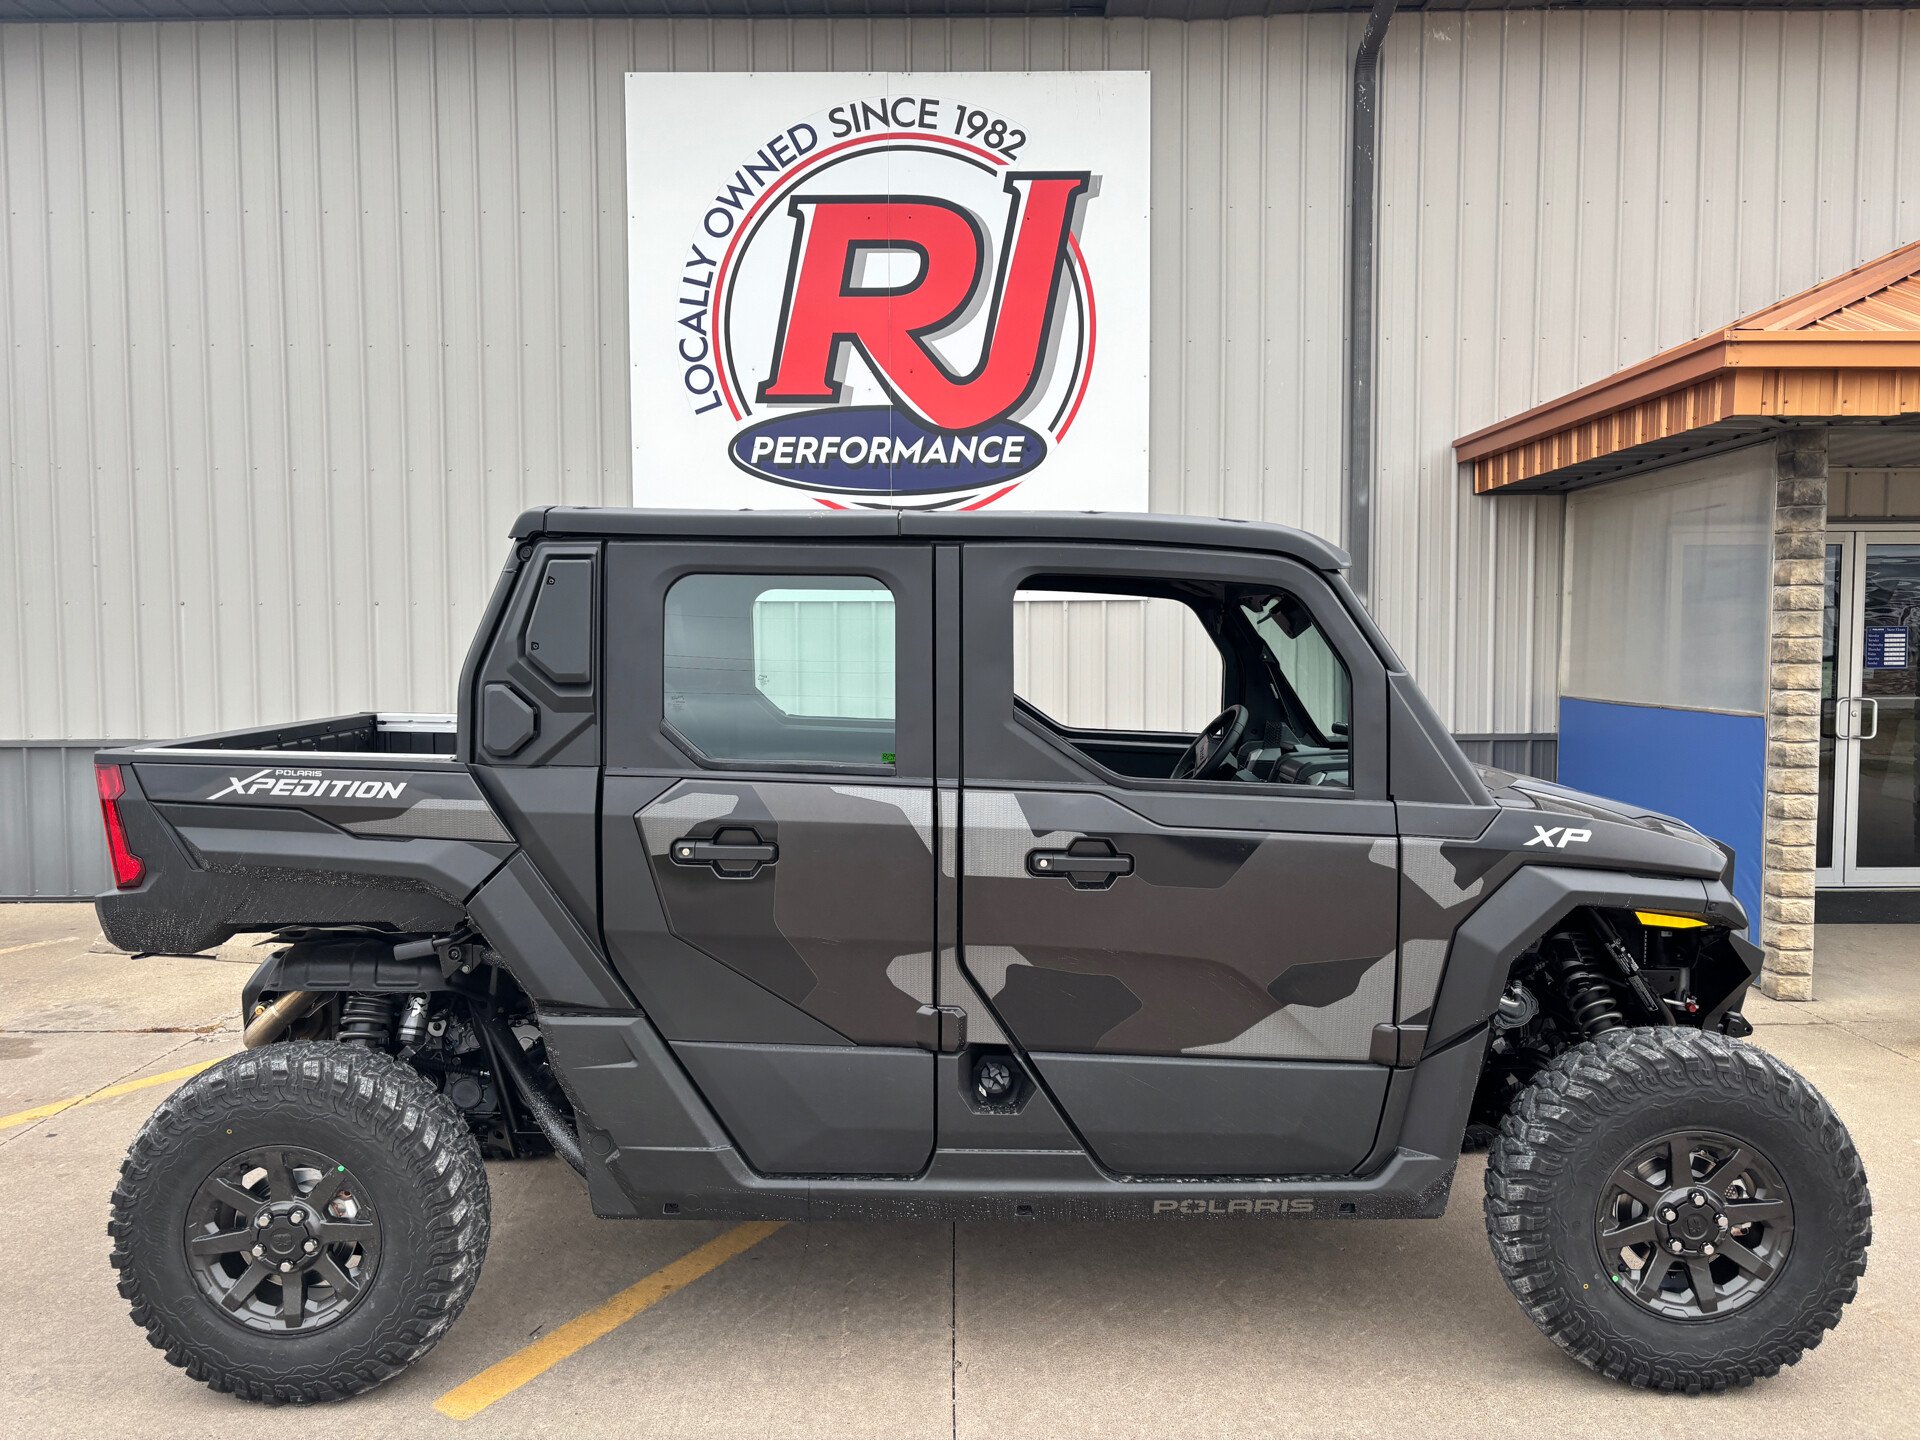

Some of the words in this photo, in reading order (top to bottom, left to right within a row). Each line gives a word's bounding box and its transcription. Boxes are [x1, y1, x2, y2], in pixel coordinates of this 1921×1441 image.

[677, 243, 723, 415] LOCALLY
[704, 123, 818, 238] OWNED
[828, 97, 940, 138] SINCE
[954, 104, 1027, 161] 1982
[755, 170, 1093, 435] RJ
[750, 434, 1026, 466] PERFORMANCE
[206, 769, 408, 800] XPEDITION
[275, 769, 323, 777] POLARIS
[1522, 825, 1593, 849] XP
[1153, 1198, 1315, 1214] POLARIS
